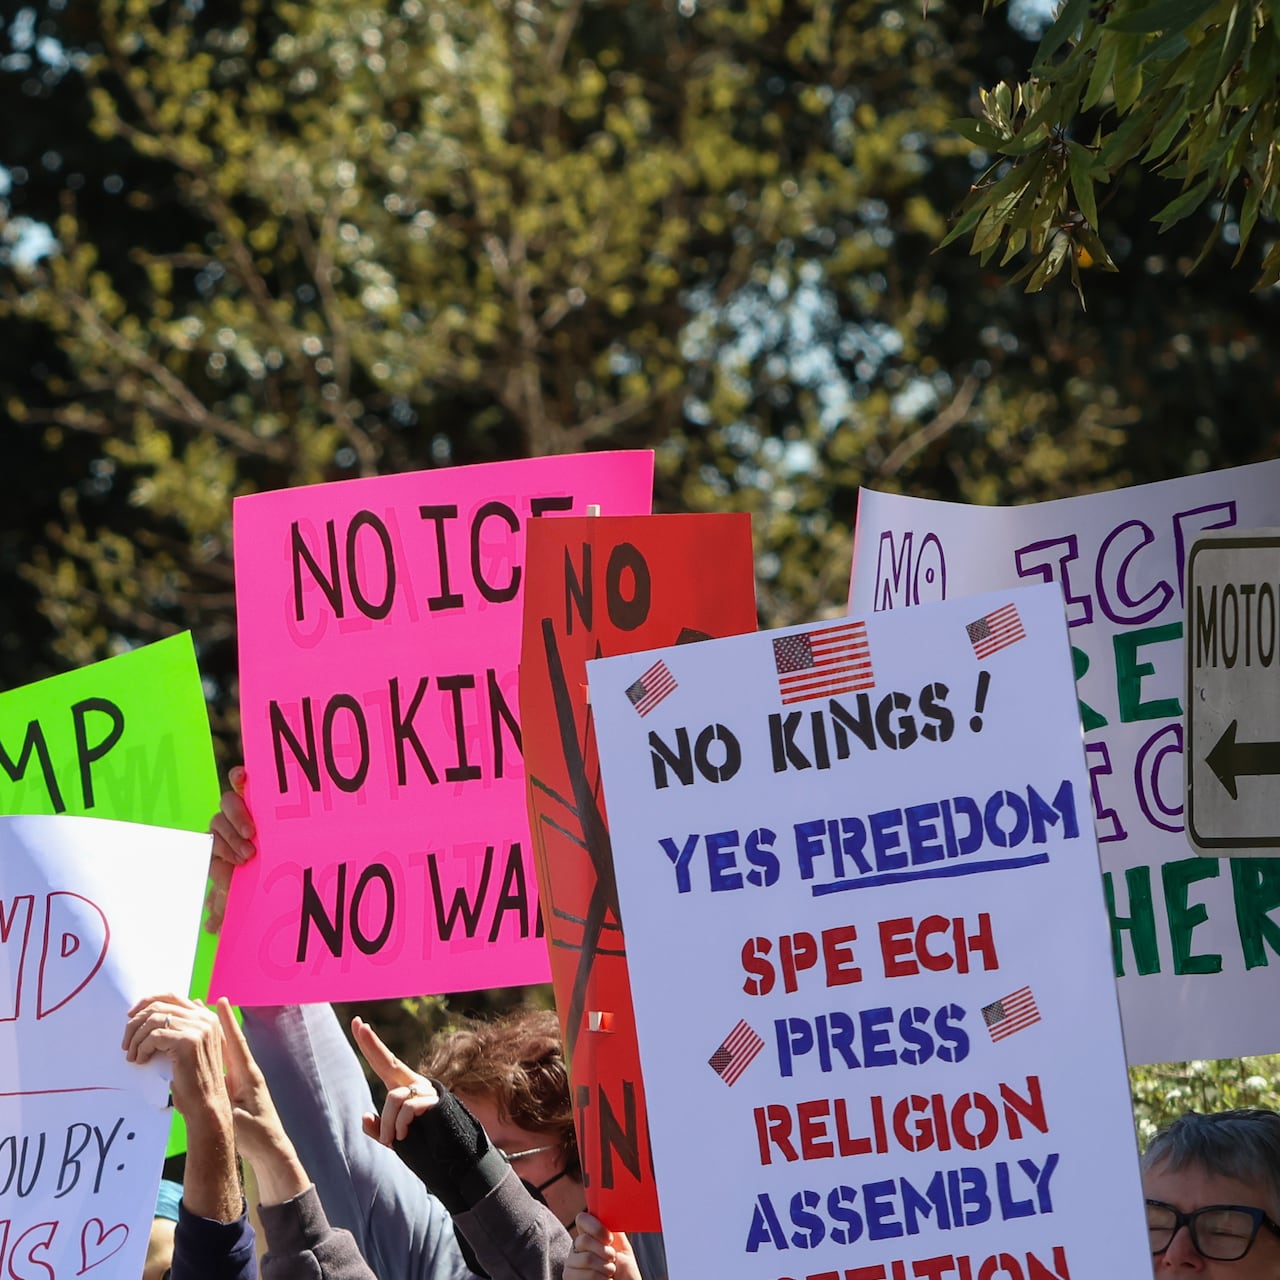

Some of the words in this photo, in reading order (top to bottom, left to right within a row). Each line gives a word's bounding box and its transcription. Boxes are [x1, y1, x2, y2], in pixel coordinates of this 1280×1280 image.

[291, 510, 397, 622] NO
[419, 495, 574, 612] IC
[564, 541, 652, 636] NO
[1195, 581, 1280, 670] MOTO
[269, 693, 371, 794] NO
[649, 723, 742, 791] NO
[658, 827, 781, 894] YES
[793, 779, 1080, 882] FREEDOM
[295, 862, 396, 963] NO
[426, 842, 545, 943] WA
[774, 1002, 970, 1078] PRESS
[55, 1116, 138, 1200] BY:
[753, 1075, 1050, 1166] RELIGION
[745, 1153, 1060, 1253] ASSEMBLY
